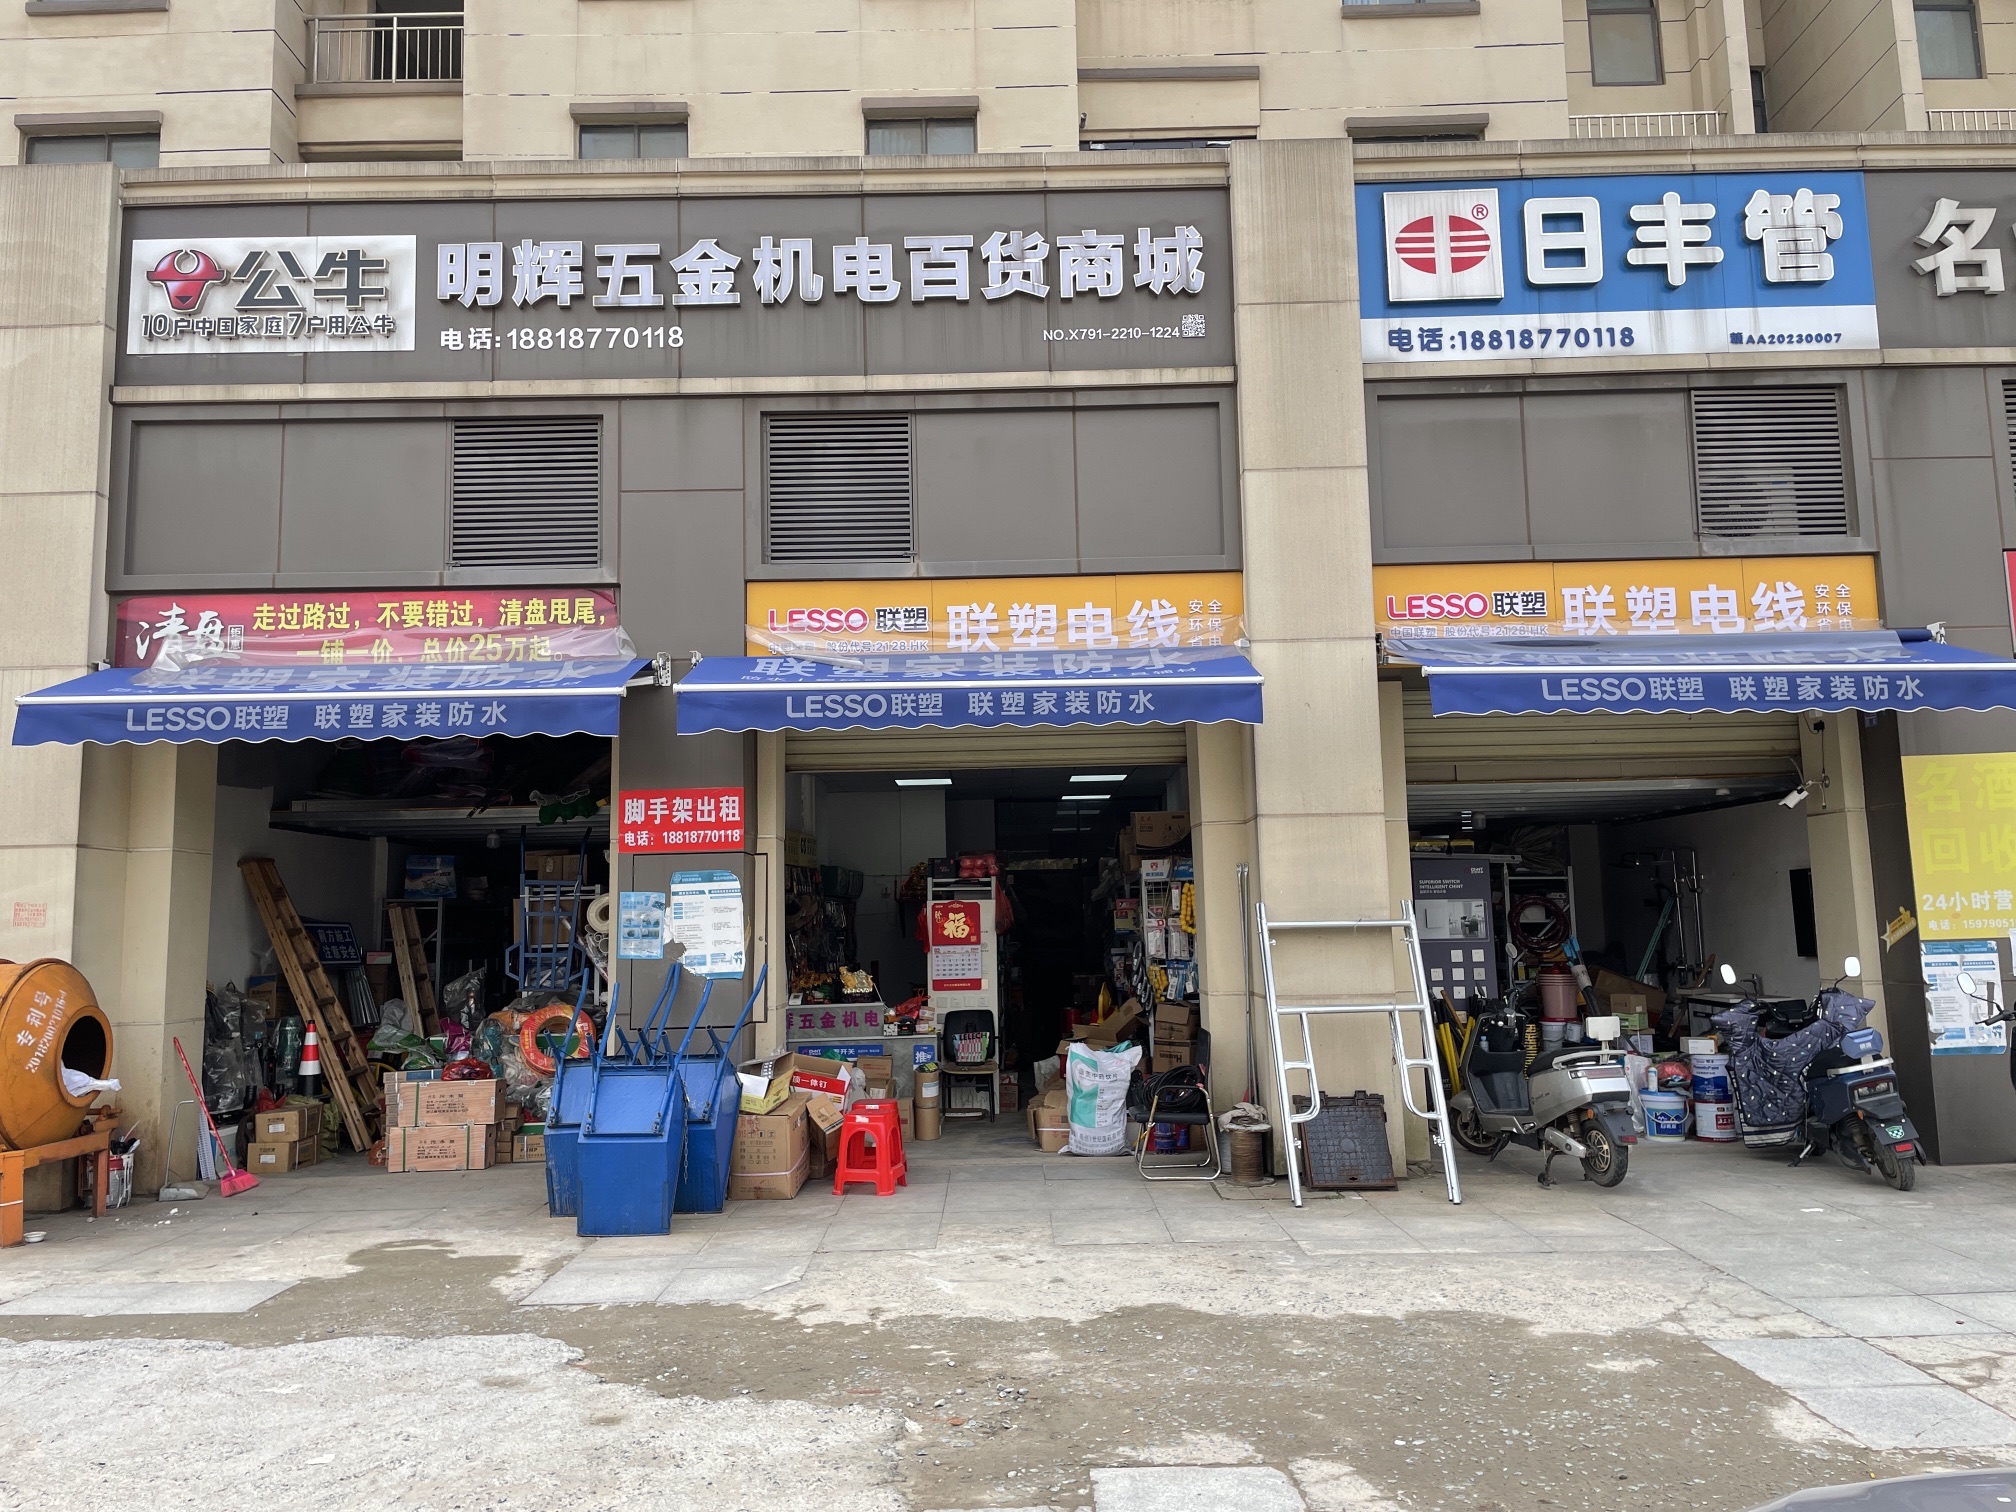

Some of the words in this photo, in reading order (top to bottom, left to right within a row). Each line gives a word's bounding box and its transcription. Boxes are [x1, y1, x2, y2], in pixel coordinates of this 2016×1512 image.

[1523, 188, 1843, 287] 日丰管
[1909, 197, 2016, 297] 名
[233, 249, 387, 310] 公牛
[437, 226, 1206, 309] 明辉五金机电百货商城
[141, 312, 395, 338] 10户中国家庭7户用公牛
[1814, 583, 1851, 598] 安全
[1188, 600, 1223, 614] 安全
[1387, 593, 1489, 619] LESSO
[1493, 591, 1547, 617] 联塑
[1561, 581, 1809, 636] 联塑电线
[1816, 601, 1853, 616] 环保
[768, 608, 869, 633] LESSO
[875, 607, 928, 632] 联塑
[946, 599, 1181, 652] 联塑电线
[1188, 618, 1223, 632] 环保
[1390, 627, 1437, 639] 中国联塑
[1730, 675, 1924, 701] 联塑家装防水
[314, 701, 508, 730] 联塑家装防水
[968, 690, 1155, 717] 联塑家装防水
[624, 796, 741, 824] 脚手架出租
[662, 829, 741, 844] 18818770118
[317, 929, 352, 943] 前方施工
[943, 912, 970, 938] 福
[322, 945, 358, 959] 注意安全
[16, 990, 52, 1047] 专利号
